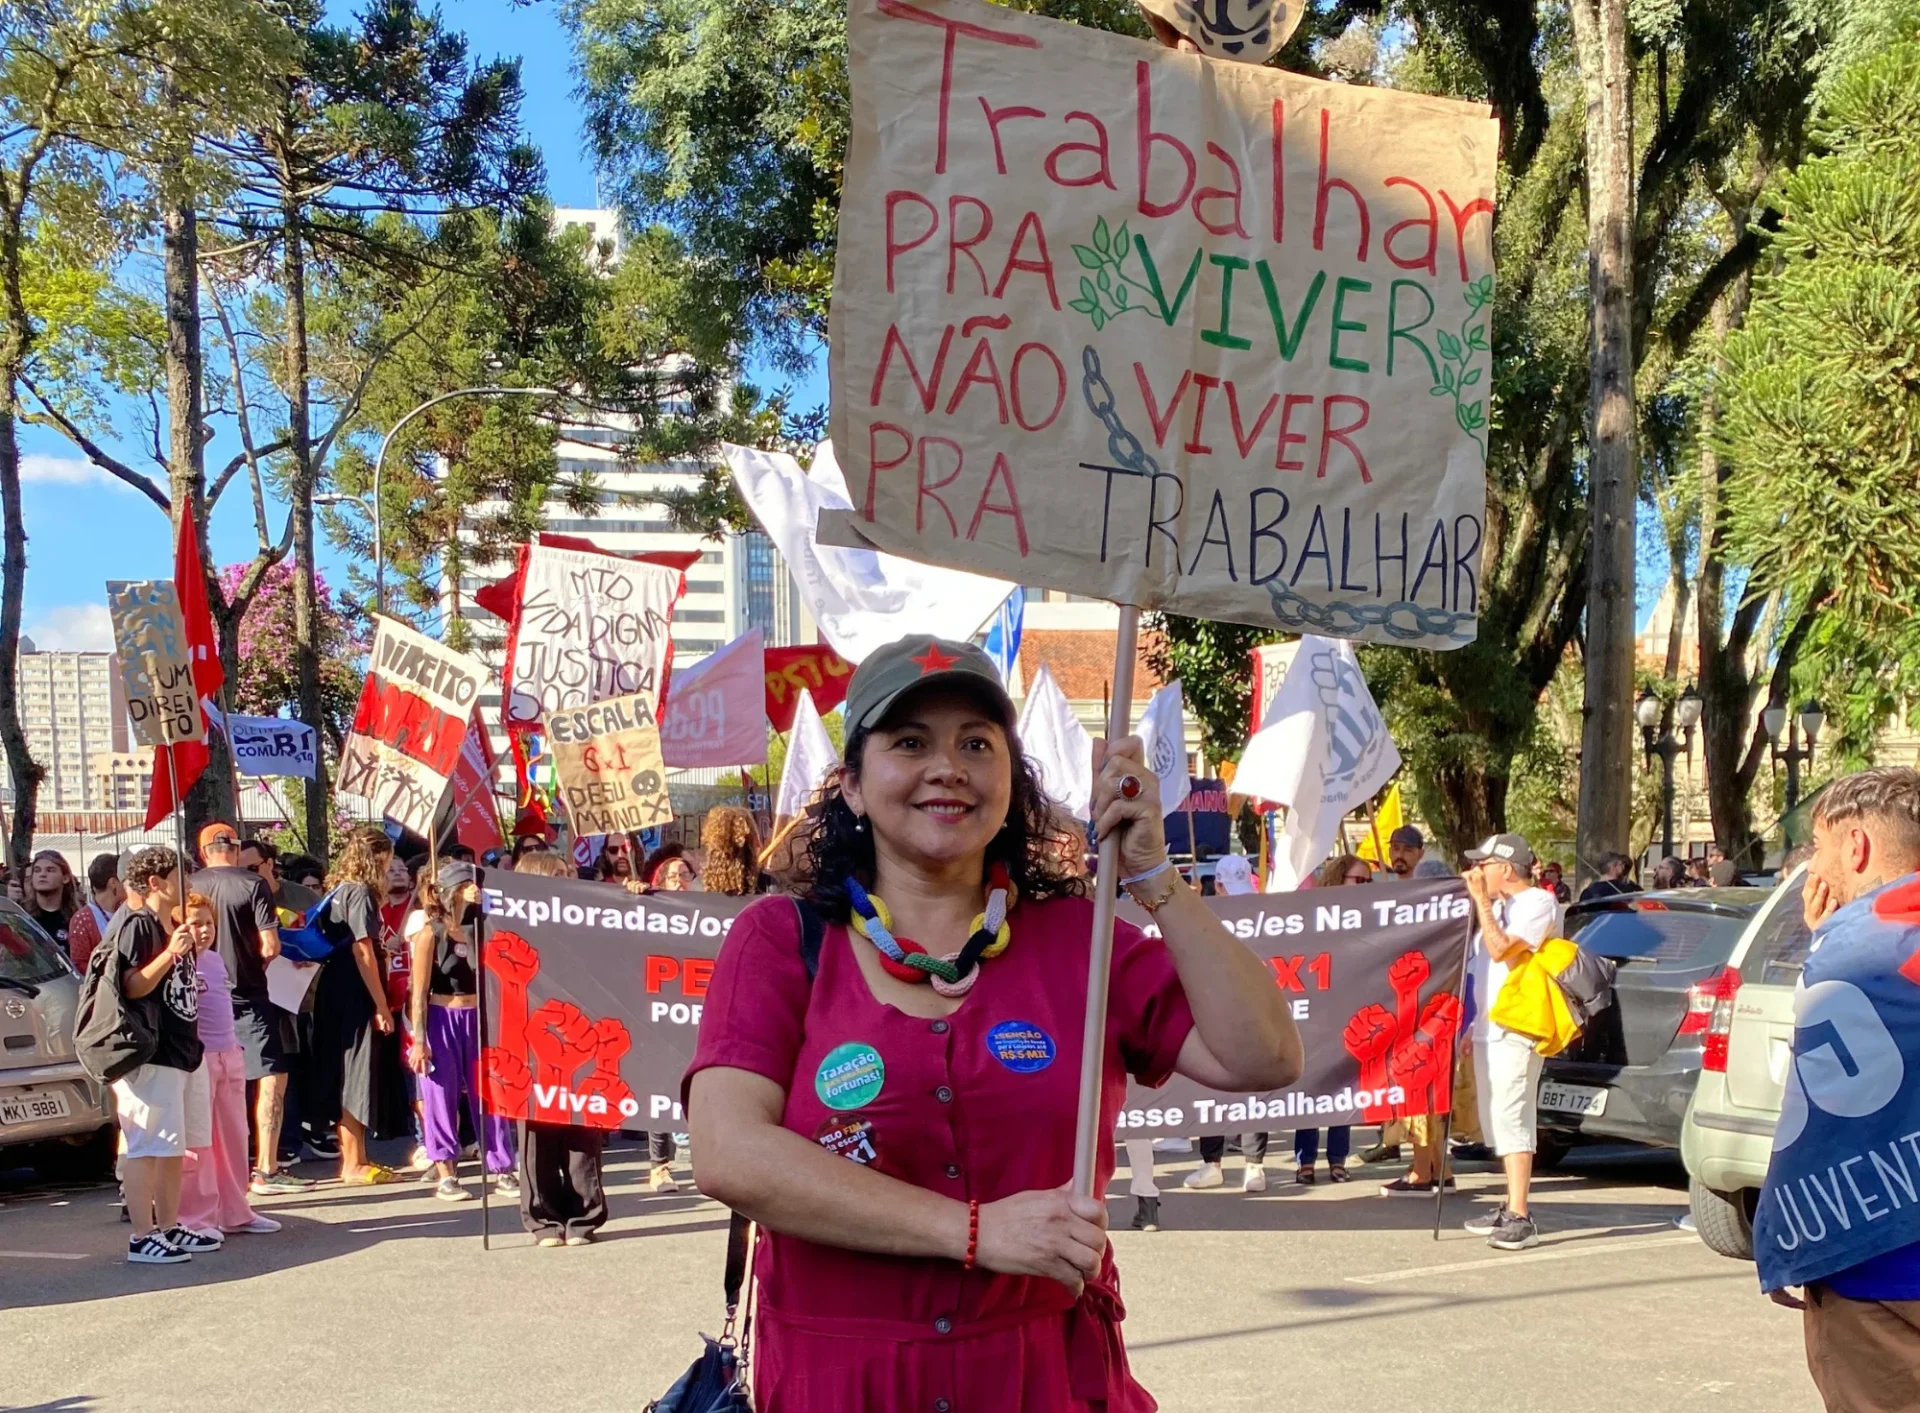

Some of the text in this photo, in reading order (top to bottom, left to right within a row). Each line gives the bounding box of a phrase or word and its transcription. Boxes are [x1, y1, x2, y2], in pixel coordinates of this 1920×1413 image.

[877, 0, 1493, 282] Trabalhar
[886, 190, 1441, 384] PRA VIVER
[870, 313, 1374, 484] NÃO VIVER
[865, 421, 1481, 612] PRA TRABALHAR
[570, 568, 633, 601] MTD
[156, 664, 193, 690] UM
[765, 654, 849, 704] PSTU
[551, 697, 655, 742] ESCALA
[568, 781, 626, 809] DESU
[576, 806, 642, 836] MANO
[1316, 904, 1362, 932] Na
[1372, 893, 1471, 927] Tarifa
[1263, 953, 1332, 993] X1
[821, 1053, 876, 1081] Taxação
[826, 1069, 881, 1099] fortunas!
[533, 1083, 608, 1115] Viva
[619, 1098, 640, 1117] o
[1193, 1084, 1406, 1125] Trabalhadora
